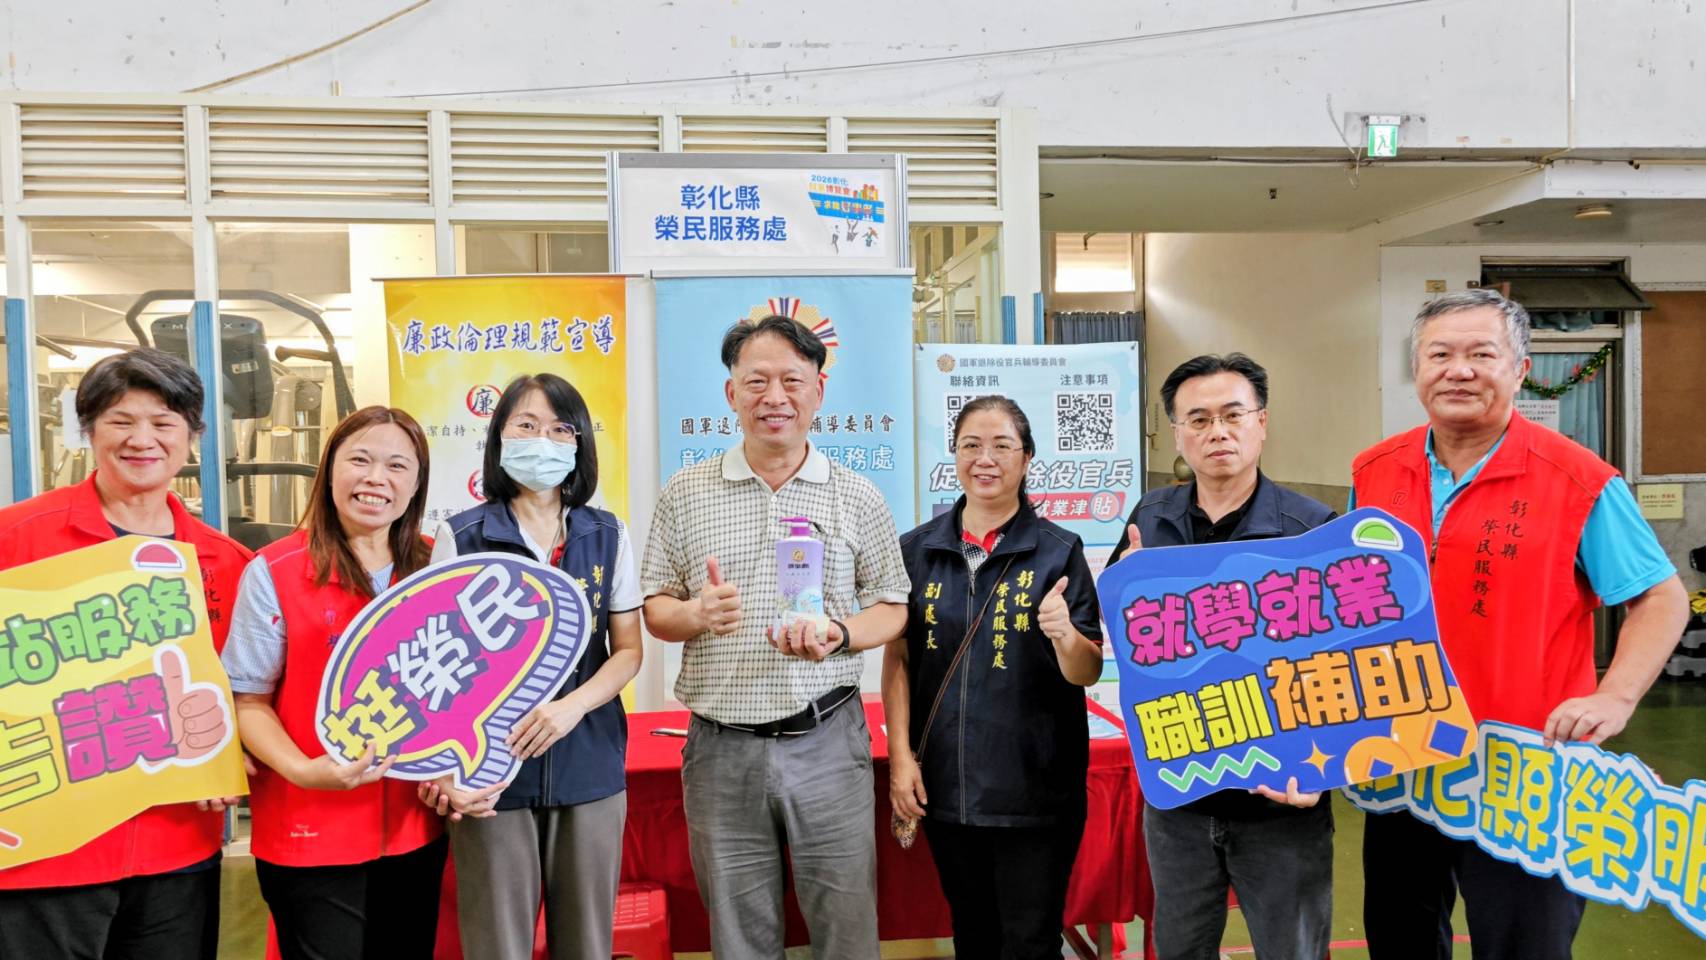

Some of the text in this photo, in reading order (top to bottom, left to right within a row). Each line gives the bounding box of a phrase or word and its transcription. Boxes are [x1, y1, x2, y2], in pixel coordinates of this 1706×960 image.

[655, 215, 787, 241] 榮民服務處
[681, 184, 760, 211] 彰化縣
[403, 317, 616, 355] 廉政倫理規範宣導
[950, 374, 1000, 387] 聯絡資訊
[1060, 373, 1109, 386] 注意事項
[929, 463, 963, 492] 促
[1501, 499, 1528, 560] 彰化縣
[1471, 518, 1500, 618] 榮民服務處
[924, 582, 942, 650] 副處長
[992, 582, 1010, 670] 榮民服務處
[1014, 570, 1035, 632] 彰化縣
[1122, 554, 1404, 666] 就學就業
[321, 562, 541, 760] 挺榮民
[1133, 638, 1452, 762] 職訓補助
